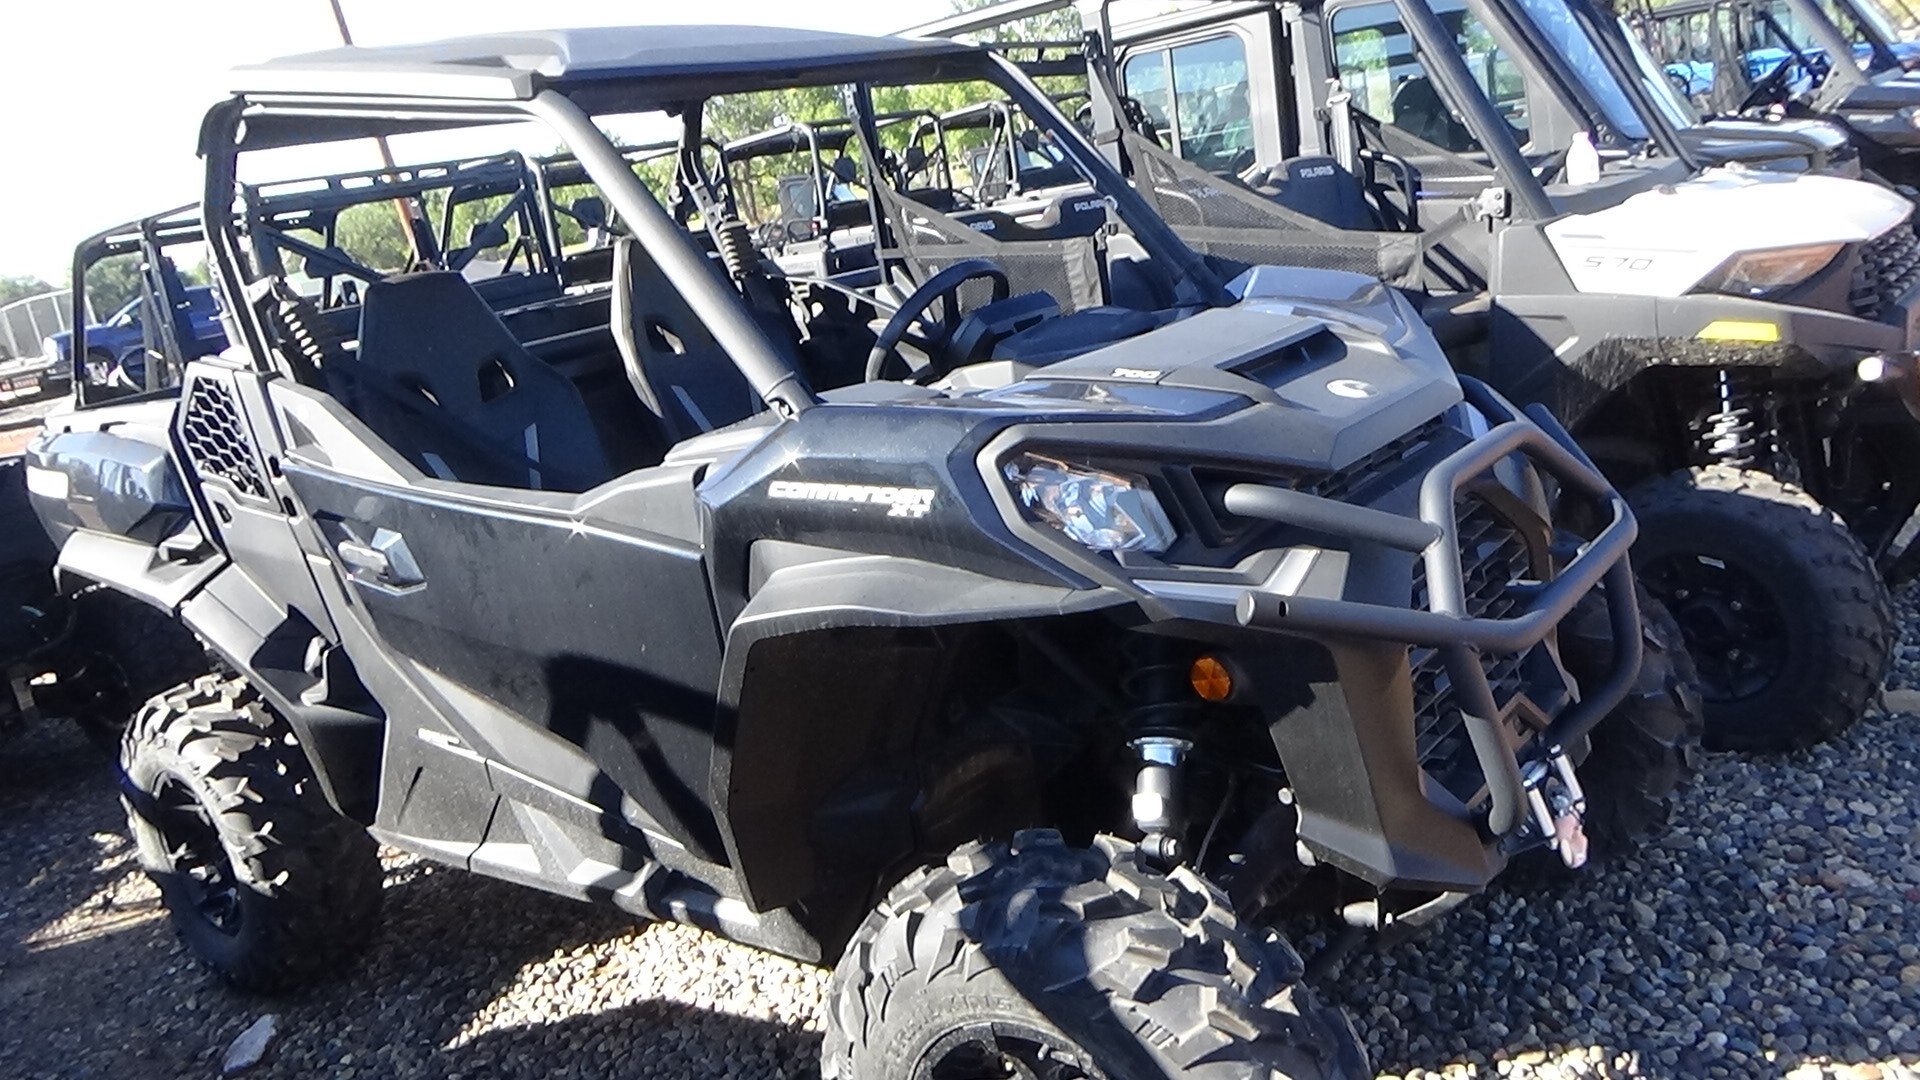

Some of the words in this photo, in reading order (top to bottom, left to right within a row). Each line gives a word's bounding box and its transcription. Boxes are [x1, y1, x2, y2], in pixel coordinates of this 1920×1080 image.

[1299, 165, 1335, 178] POLARIS
[1073, 199, 1106, 212] POLARI
[1111, 367, 1162, 379] 700
[768, 480, 936, 505] COMMANDER
[886, 502, 932, 518] XT
